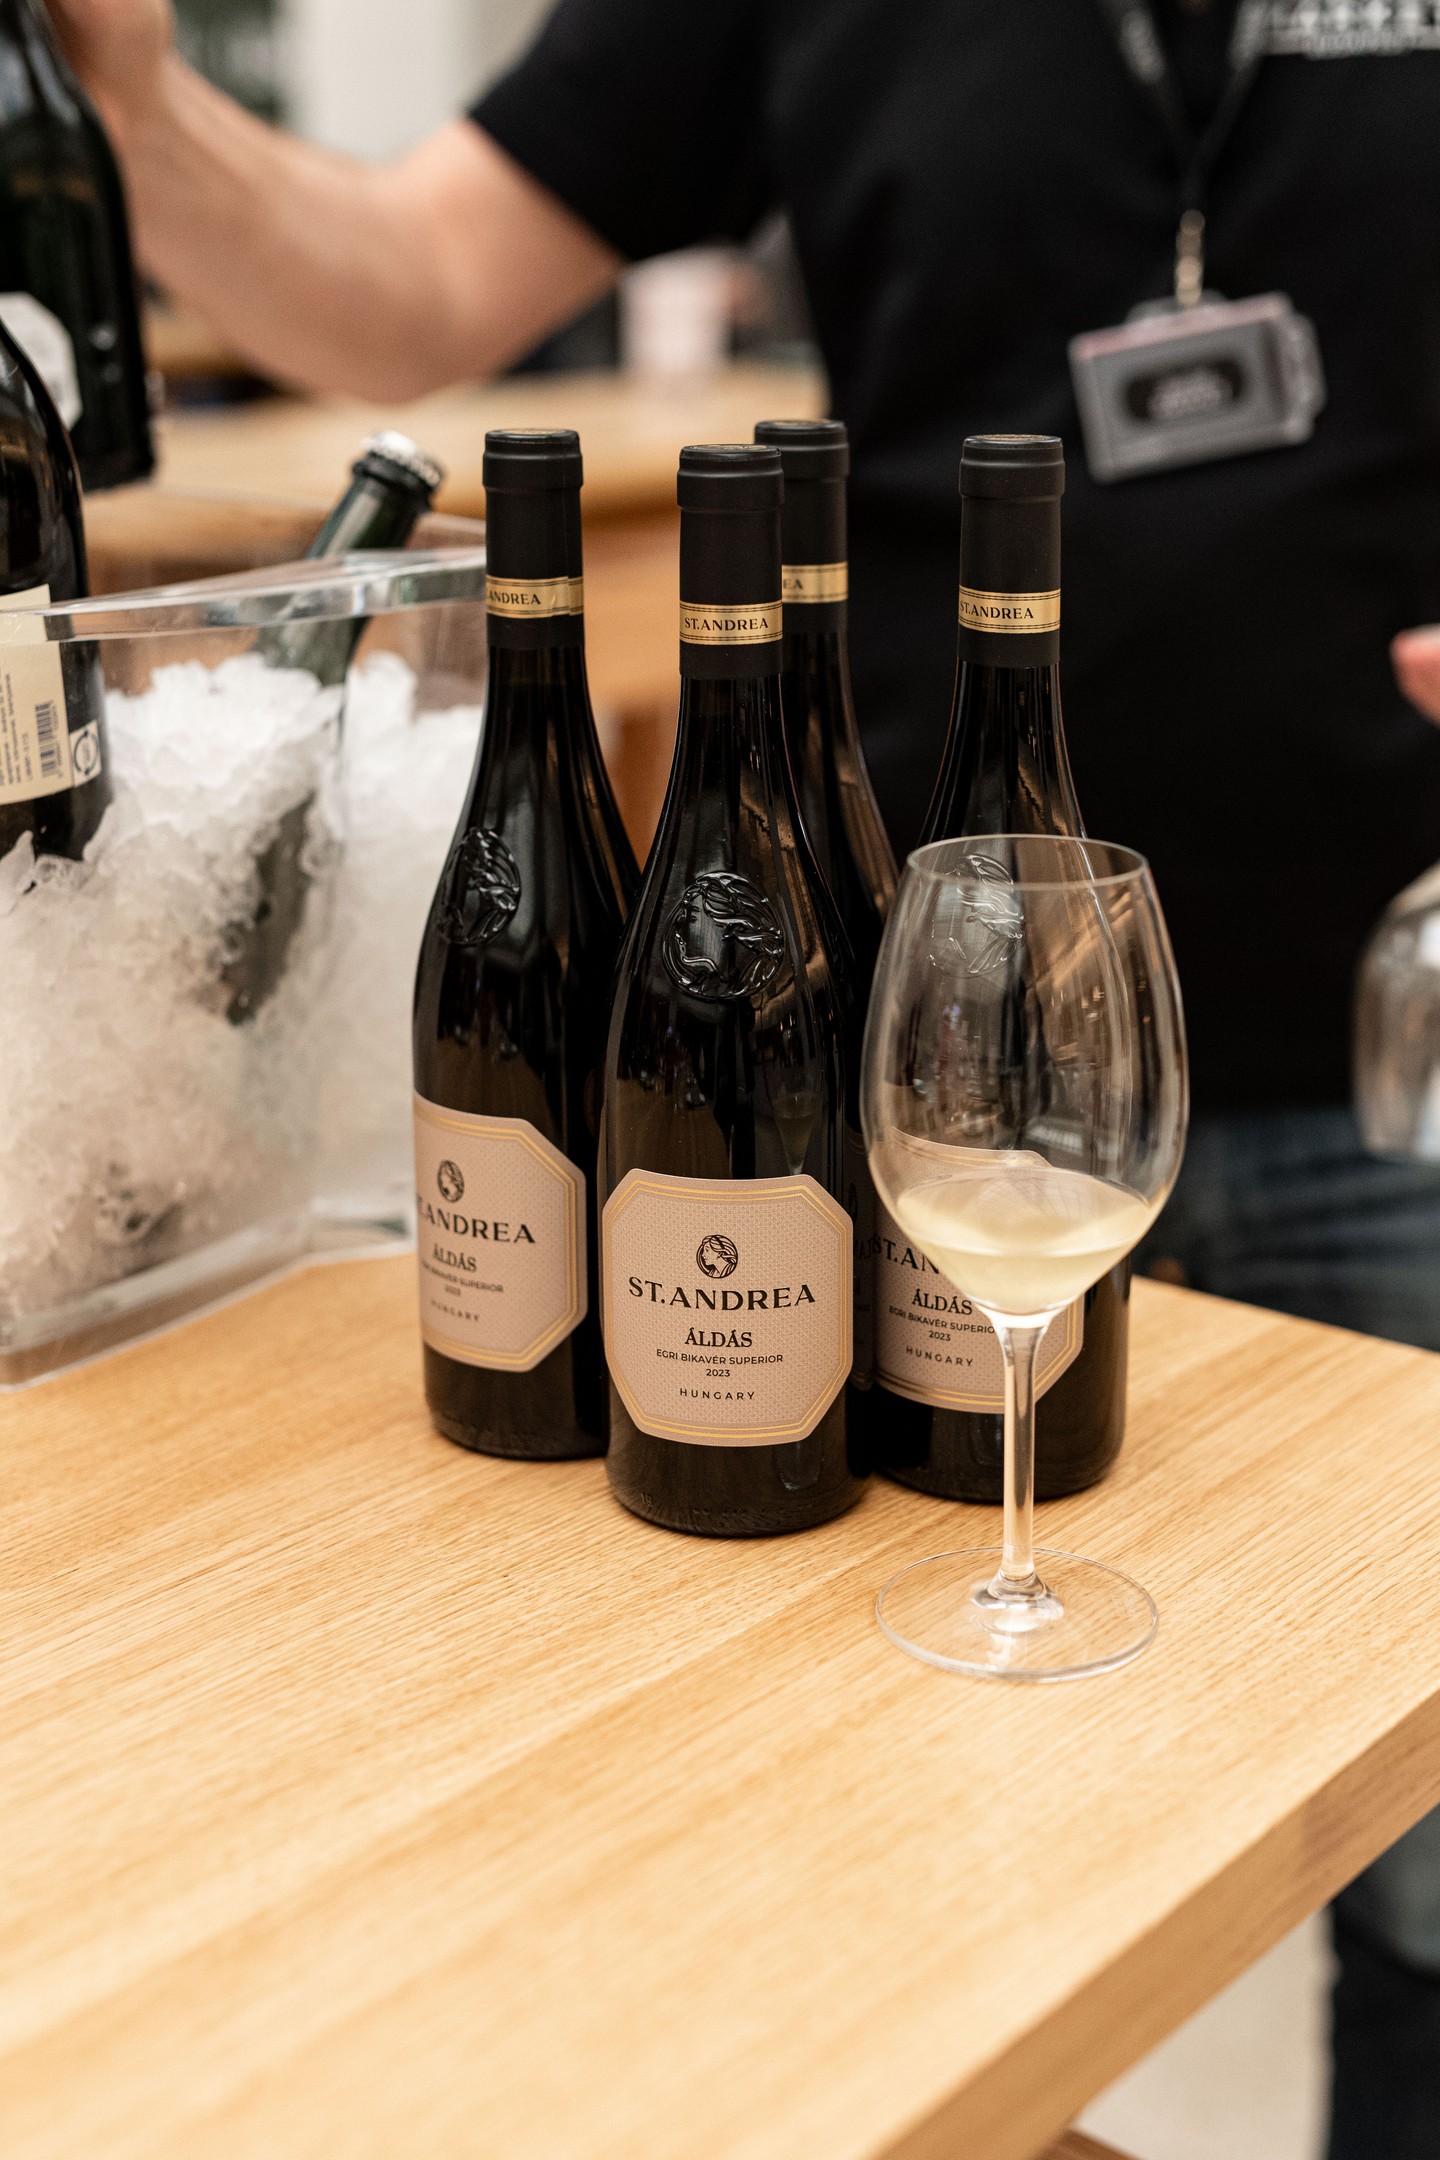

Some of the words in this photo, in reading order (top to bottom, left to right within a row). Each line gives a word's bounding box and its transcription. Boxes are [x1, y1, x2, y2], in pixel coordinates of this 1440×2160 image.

[489, 590, 541, 605] ANDREA
[960, 601, 1034, 620] ST.ANDREA
[684, 617, 769, 631] ST.ANDREA
[872, 1234, 940, 1275] ST.AN
[628, 1276, 816, 1311] ST.ANDREA
[912, 1288, 973, 1316] ÁLDÁS
[908, 1312, 948, 1328] BIKAVÉR
[949, 1321, 995, 1334] SUPERIO
[684, 1326, 753, 1348] ÁLDÁS
[928, 1329, 951, 1342] 2023
[656, 1348, 679, 1360] EGRI
[681, 1353, 726, 1365] BIKAVÉR
[729, 1354, 784, 1365] SUPERIOR
[905, 1345, 974, 1367] HUNGARY
[705, 1368, 731, 1378] 2023
[679, 1388, 755, 1400] HUNGARY
